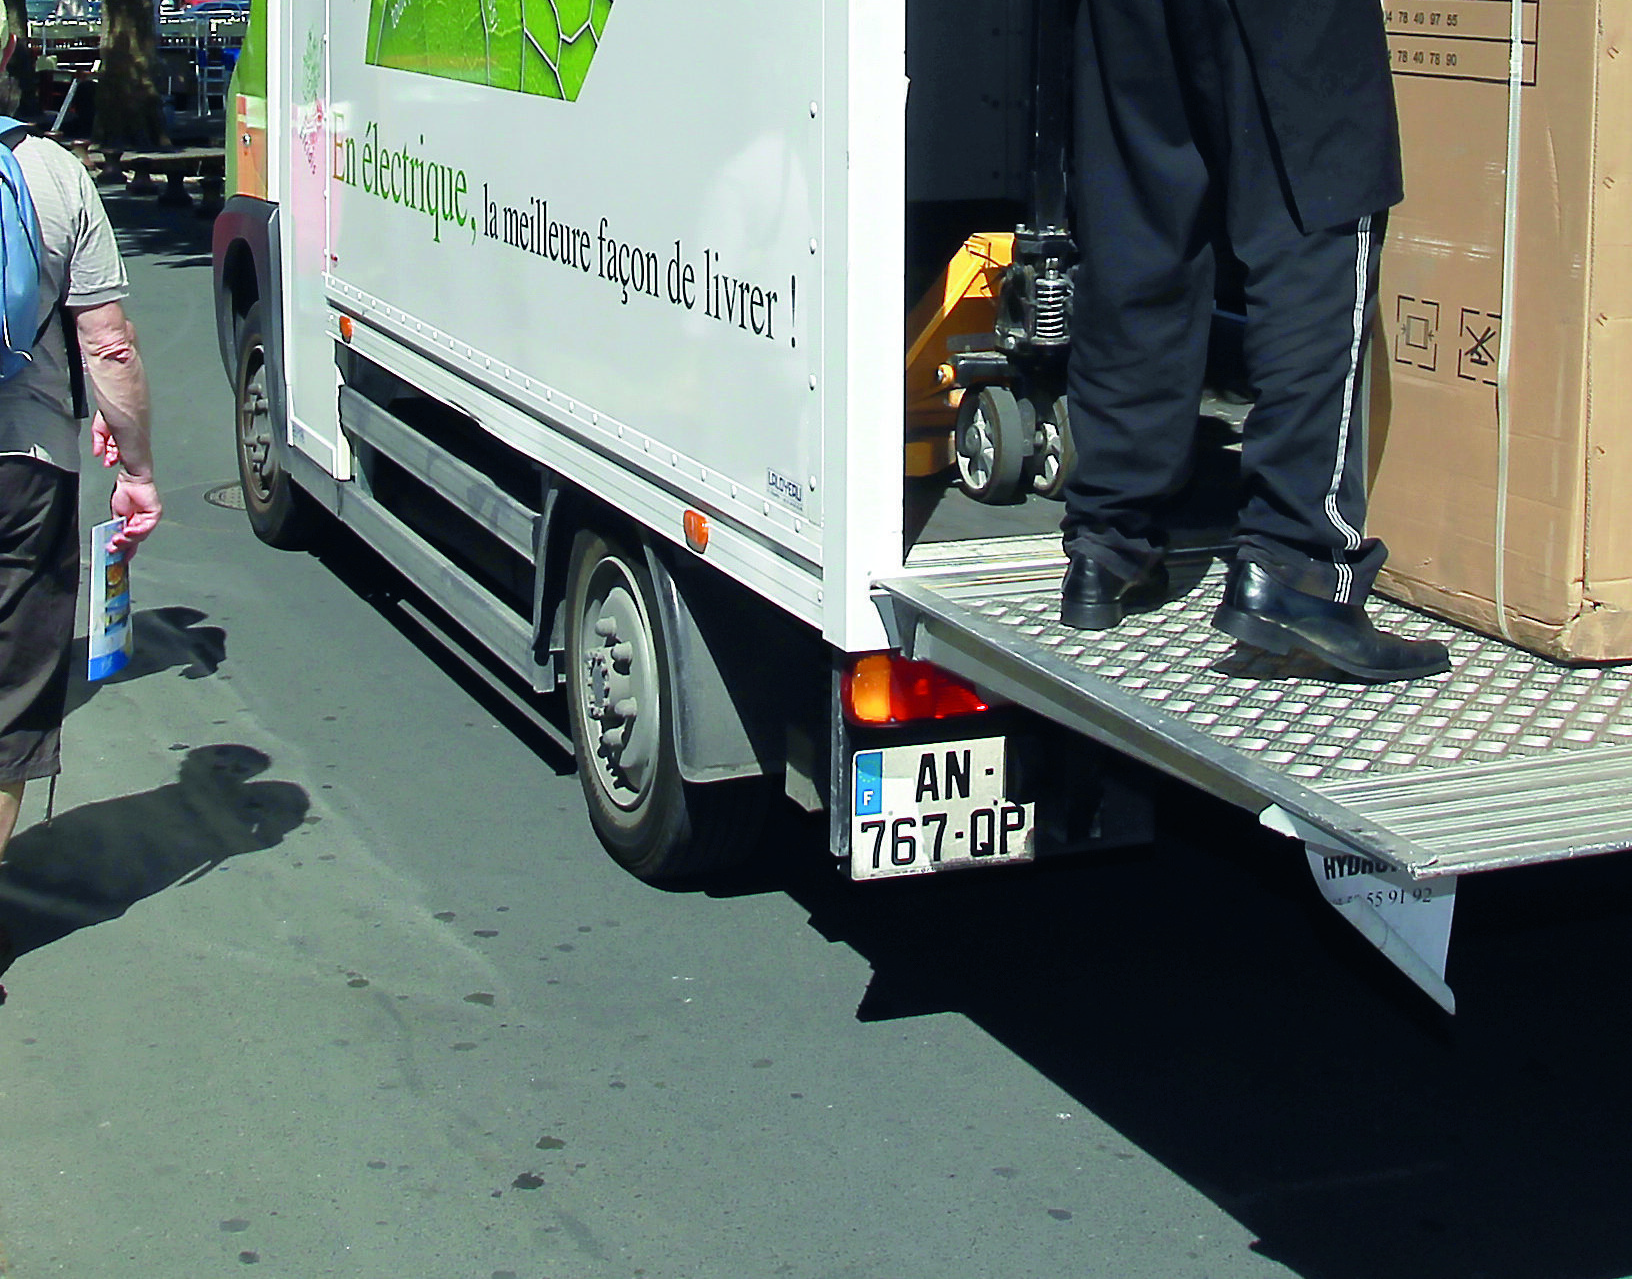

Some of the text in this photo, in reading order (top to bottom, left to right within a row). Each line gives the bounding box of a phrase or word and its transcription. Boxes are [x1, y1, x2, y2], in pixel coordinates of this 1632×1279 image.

[1398, 10, 1409, 24] 78
[1413, 12, 1425, 25] 40
[1429, 13, 1441, 26] 97
[1446, 14, 1458, 27] 55
[1397, 50, 1457, 66] 78 40 78 90
[332, 112, 357, 187] En
[362, 121, 477, 247] électrique,
[483, 183, 499, 240] la
[503, 196, 592, 273] meilleure
[597, 217, 659, 305] façon
[666, 241, 695, 310] de
[704, 247, 778, 340] livrer
[789, 274, 798, 348] !
[862, 790, 875, 806] F
[860, 805, 1026, 869] 767-QP
[1367, 891, 1383, 907] 55
[1389, 889, 1405, 905] 91
[1413, 887, 1433, 903] 92
